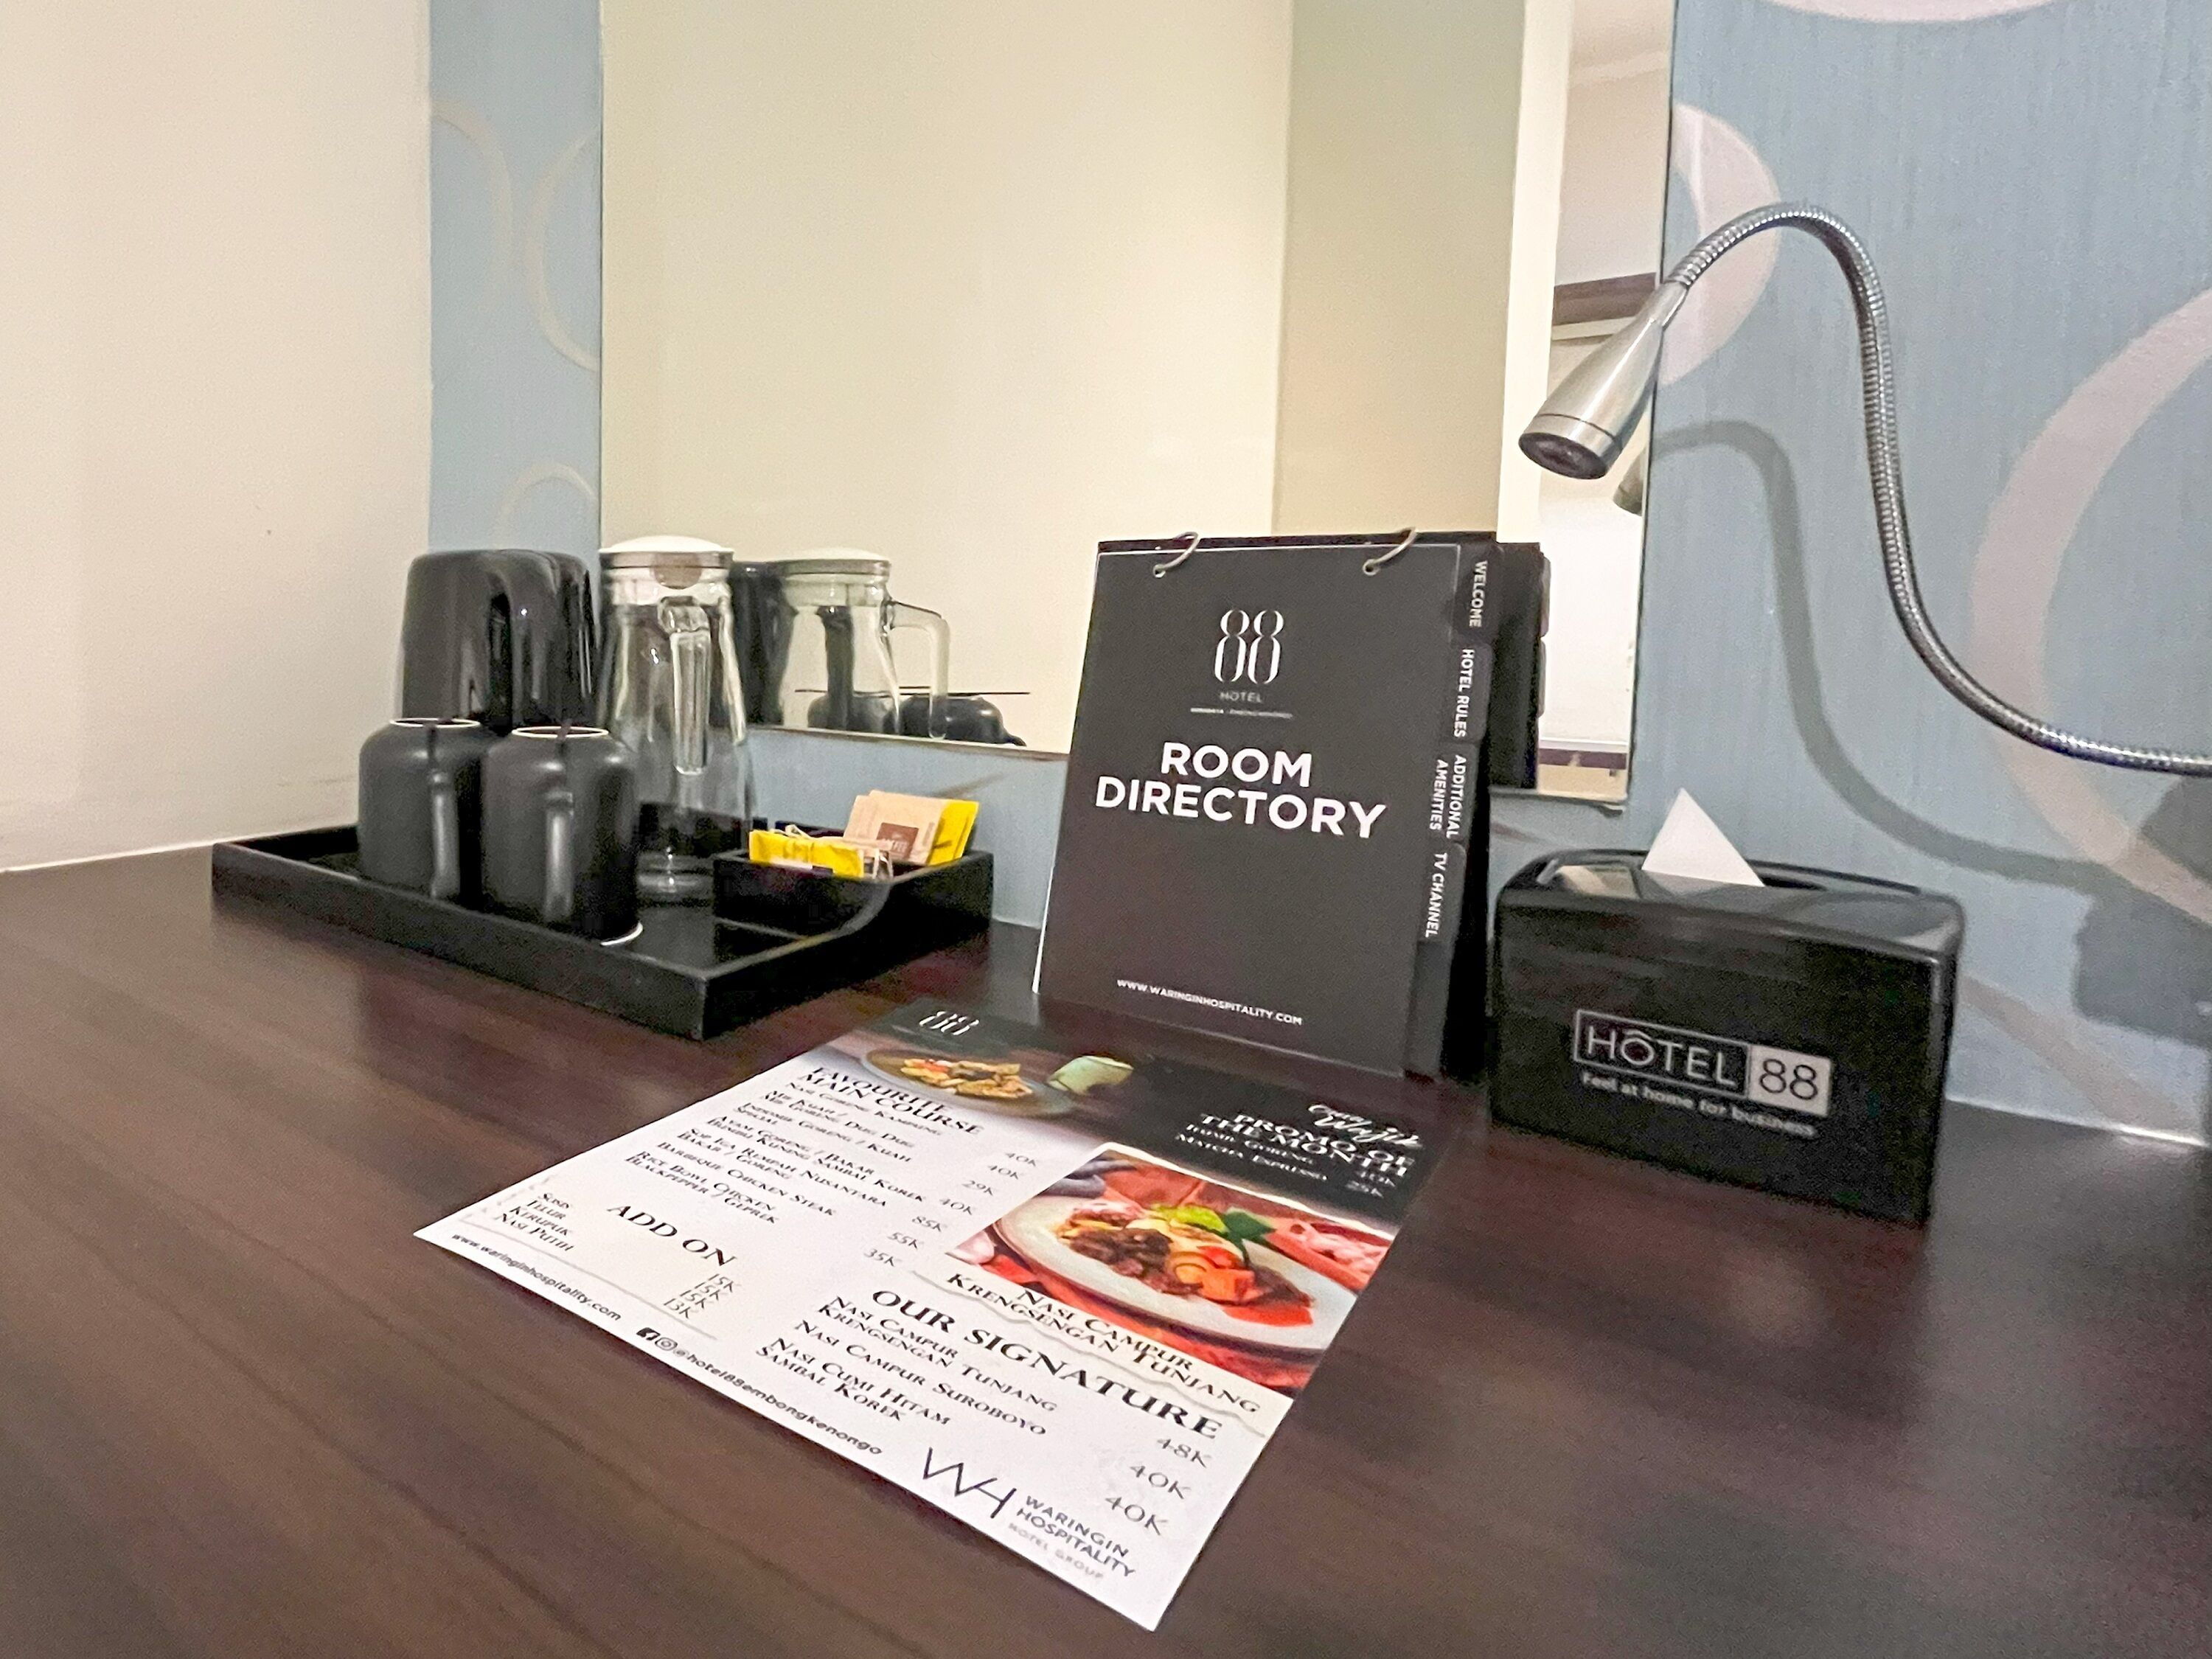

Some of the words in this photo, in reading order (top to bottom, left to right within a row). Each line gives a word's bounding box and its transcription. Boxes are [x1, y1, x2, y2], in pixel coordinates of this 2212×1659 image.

[1469, 560, 1488, 627] WELCOME
[1214, 609, 1283, 684] 88
[1458, 649, 1475, 692] HOTEL
[1220, 692, 1263, 703] HOTEL
[1454, 695, 1470, 737] RULES
[1161, 742, 1312, 787] ROOM
[1095, 776, 1386, 839] DIRECTORY
[1430, 759, 1449, 830] AMENITIES
[1446, 754, 1467, 839] ADDITIONAL
[1434, 852, 1447, 871] TV
[1425, 873, 1444, 938] CHANNEL
[1117, 979, 1302, 1025] WWW.WARINGINHOSPITALITY.COM
[811, 1067, 956, 1112] FAVOURITE
[1642, 1086, 1694, 1108] home
[1699, 1099, 1727, 1115] for
[1759, 1058, 1820, 1101] 88
[799, 1074, 869, 1099] MAIN
[875, 1097, 984, 1135] COURSE
[1200, 1113, 1260, 1138] THE
[1270, 1134, 1408, 1176] MONTH
[1234, 1114, 1356, 1152] PROMO
[1366, 1150, 1415, 1166] OF
[607, 1206, 678, 1237] ADD
[682, 1239, 737, 1266] ON
[887, 1231, 925, 1250] 55K
[912, 1215, 948, 1232] 85K
[451, 1234, 622, 1321] www.waringinhospitality.com
[864, 1248, 902, 1267] 35K
[680, 1290, 714, 1310] 15K
[694, 1281, 729, 1301] 15K
[708, 1273, 742, 1293] 15K
[664, 1298, 699, 1319] 13K
[872, 1290, 955, 1333] OUR
[964, 1328, 1223, 1439] SIGNATURE
[1157, 1437, 1213, 1468] 48K
[1130, 1465, 1192, 1500] 40K
[1008, 1522, 1048, 1551] HOTEL
[1026, 1495, 1130, 1558] WARINGIN
[1105, 1496, 1168, 1537] 40K
[1016, 1508, 1136, 1578] HOSPITALITY
